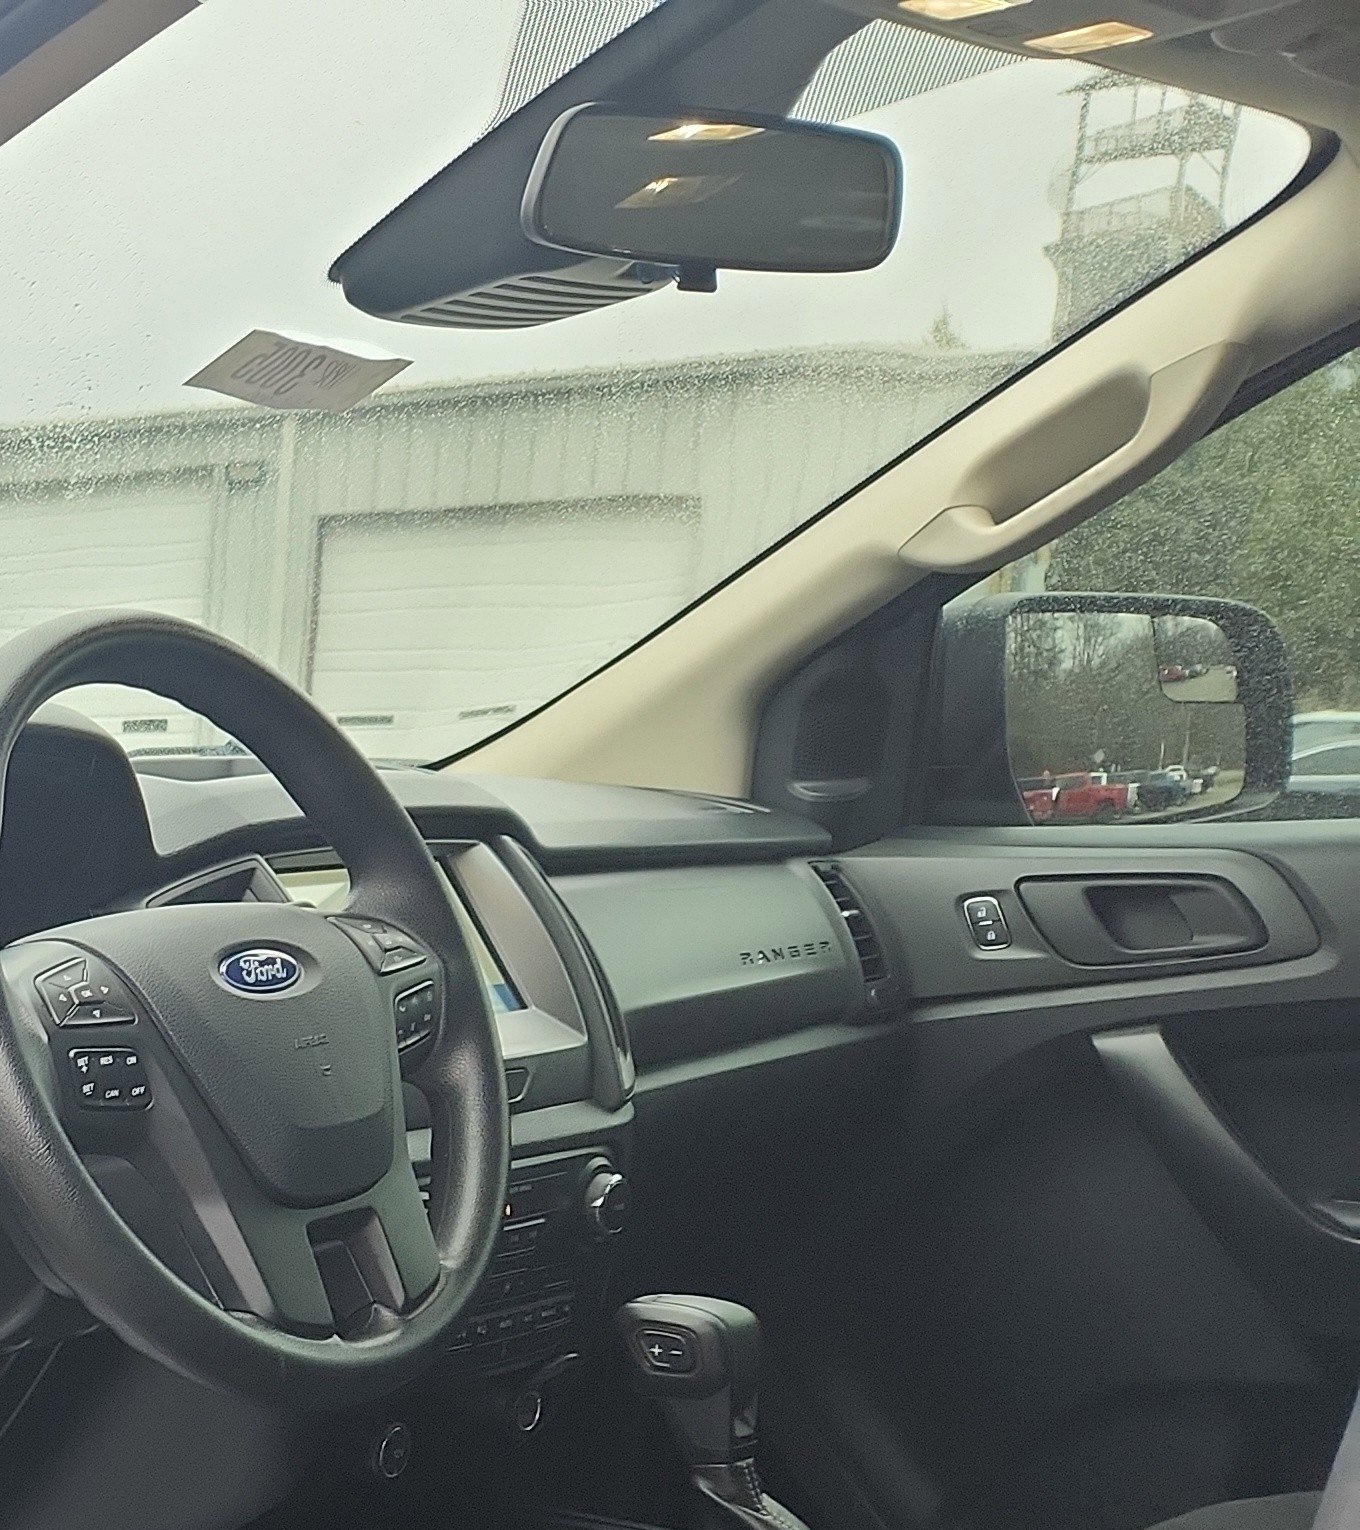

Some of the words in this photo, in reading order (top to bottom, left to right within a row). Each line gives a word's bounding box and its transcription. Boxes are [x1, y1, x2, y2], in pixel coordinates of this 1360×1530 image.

[739, 941, 831, 966] RANGER
[239, 956, 287, 983] Ford
[105, 1089, 120, 1099] CAN
[131, 1085, 146, 1097] OFF
